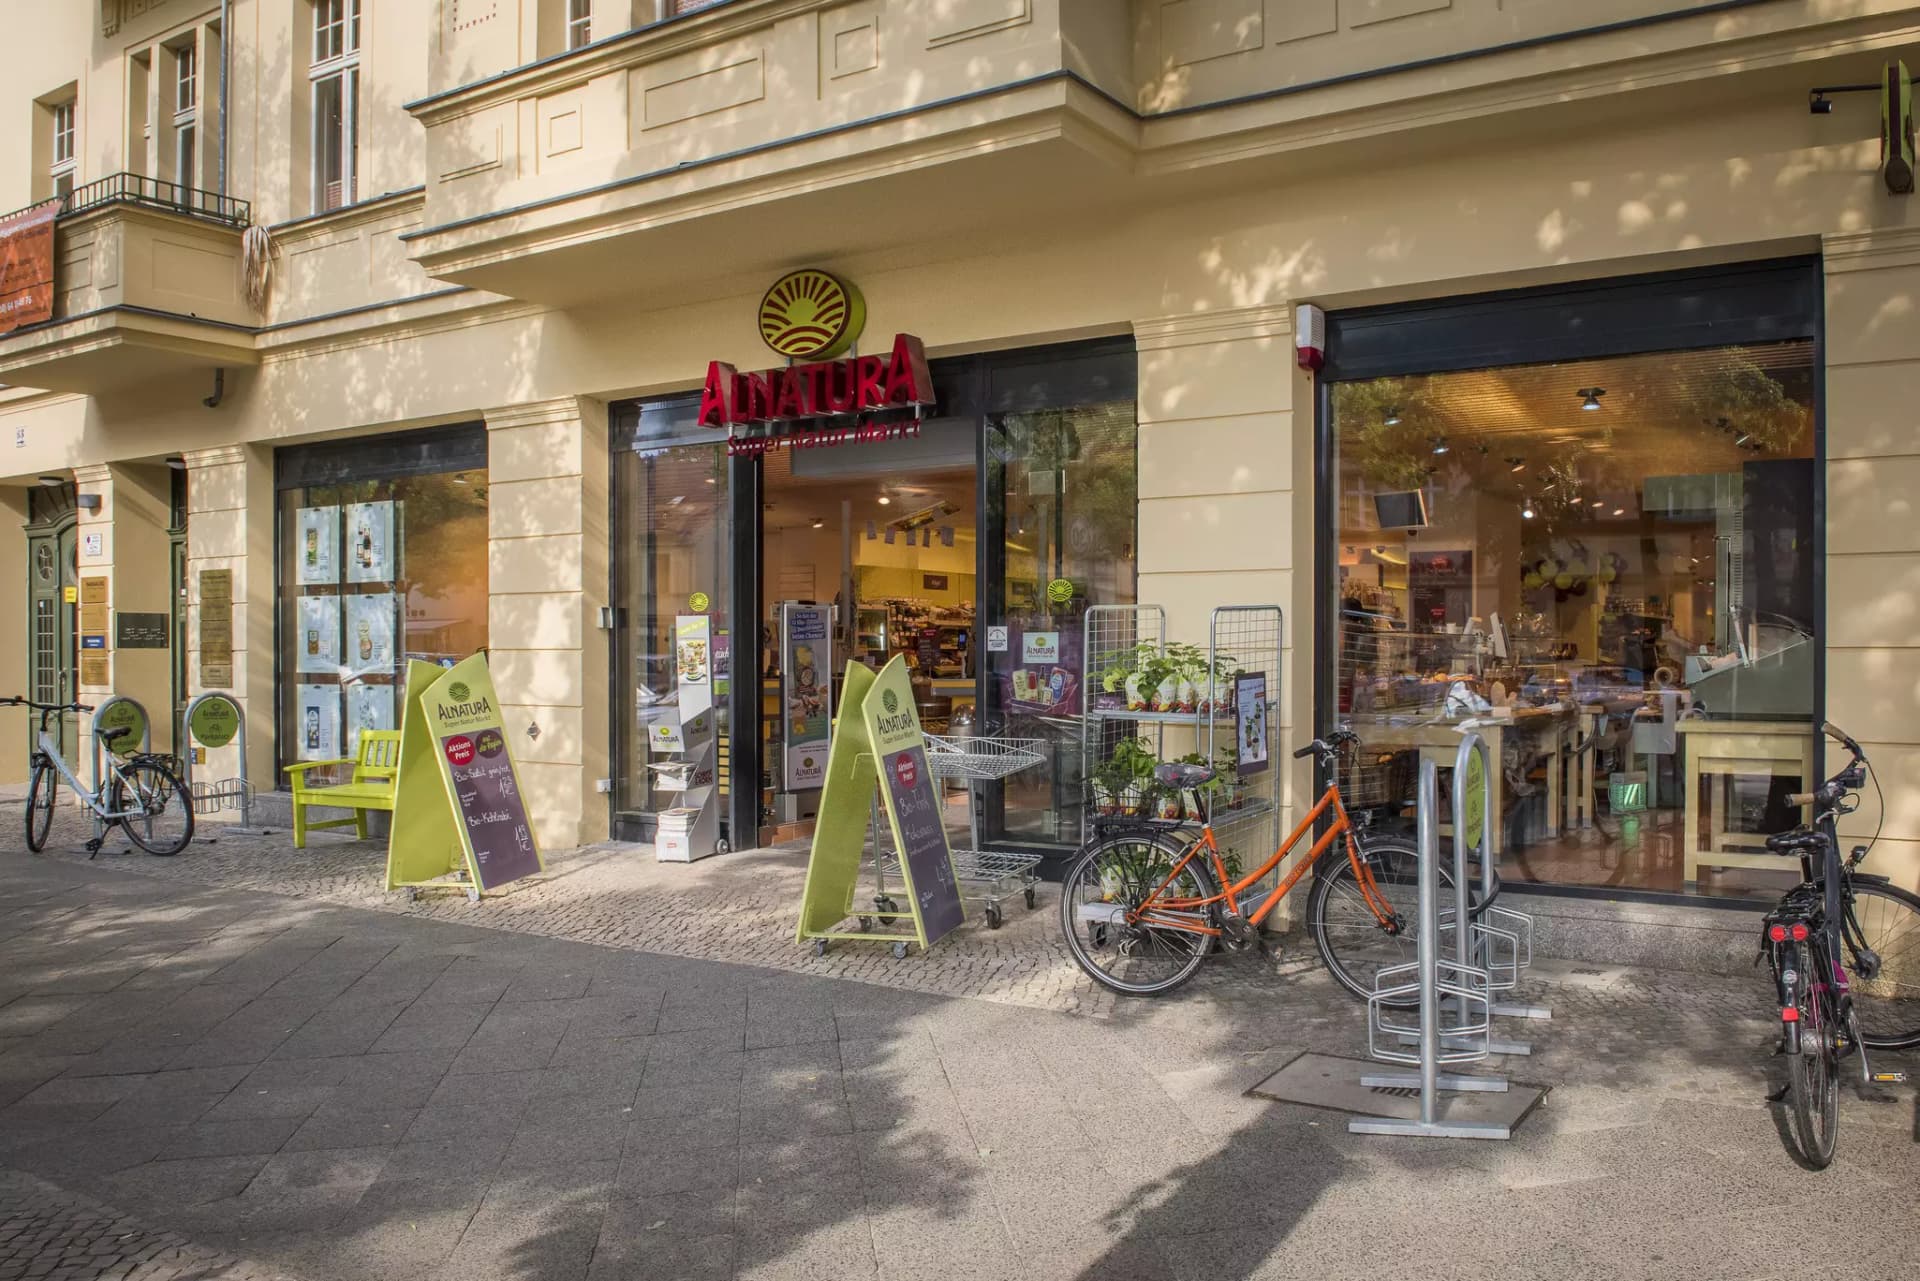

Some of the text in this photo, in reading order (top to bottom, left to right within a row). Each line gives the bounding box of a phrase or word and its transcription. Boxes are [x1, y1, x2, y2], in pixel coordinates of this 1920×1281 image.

[697, 333, 921, 427] ALNATURA
[727, 417, 921, 457] Super Natur Markt
[1027, 646, 1056, 655] ALNATURA
[437, 696, 492, 720] ALNATURA
[876, 708, 915, 735] ALNATURA
[652, 735, 679, 743] ALNATURA
[448, 741, 471, 753] Aktions
[455, 750, 470, 760] Preis
[795, 766, 822, 776] ALNATURA
